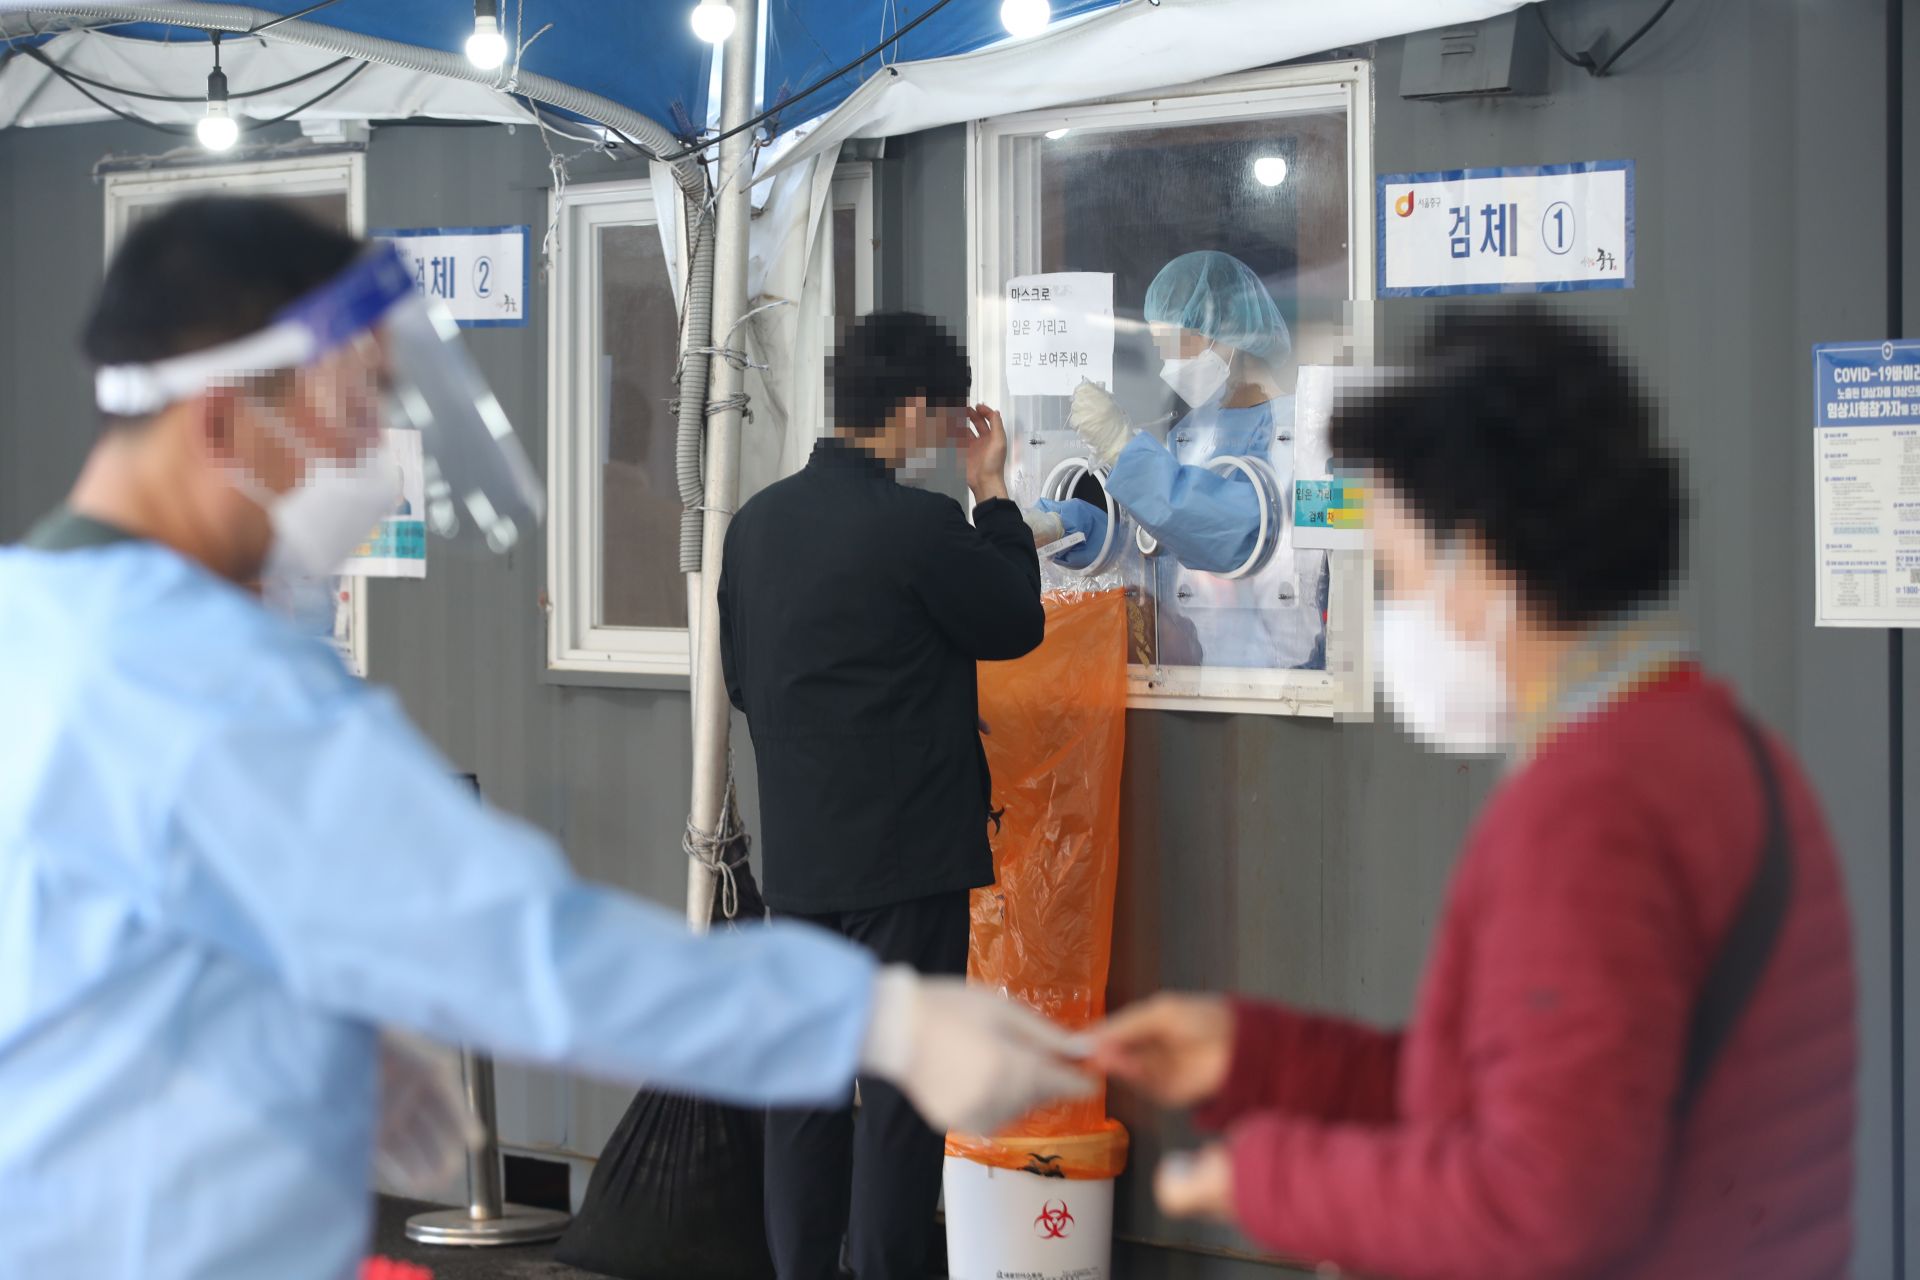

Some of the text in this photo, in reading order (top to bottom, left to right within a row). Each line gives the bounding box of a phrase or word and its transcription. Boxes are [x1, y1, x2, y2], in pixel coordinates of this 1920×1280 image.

[1448, 203, 1518, 259] 검체
[1011, 287, 1051, 303] 마스크로
[1011, 319, 1068, 336] 입은 가리고
[1011, 351, 1088, 367] 코만 보여주세요
